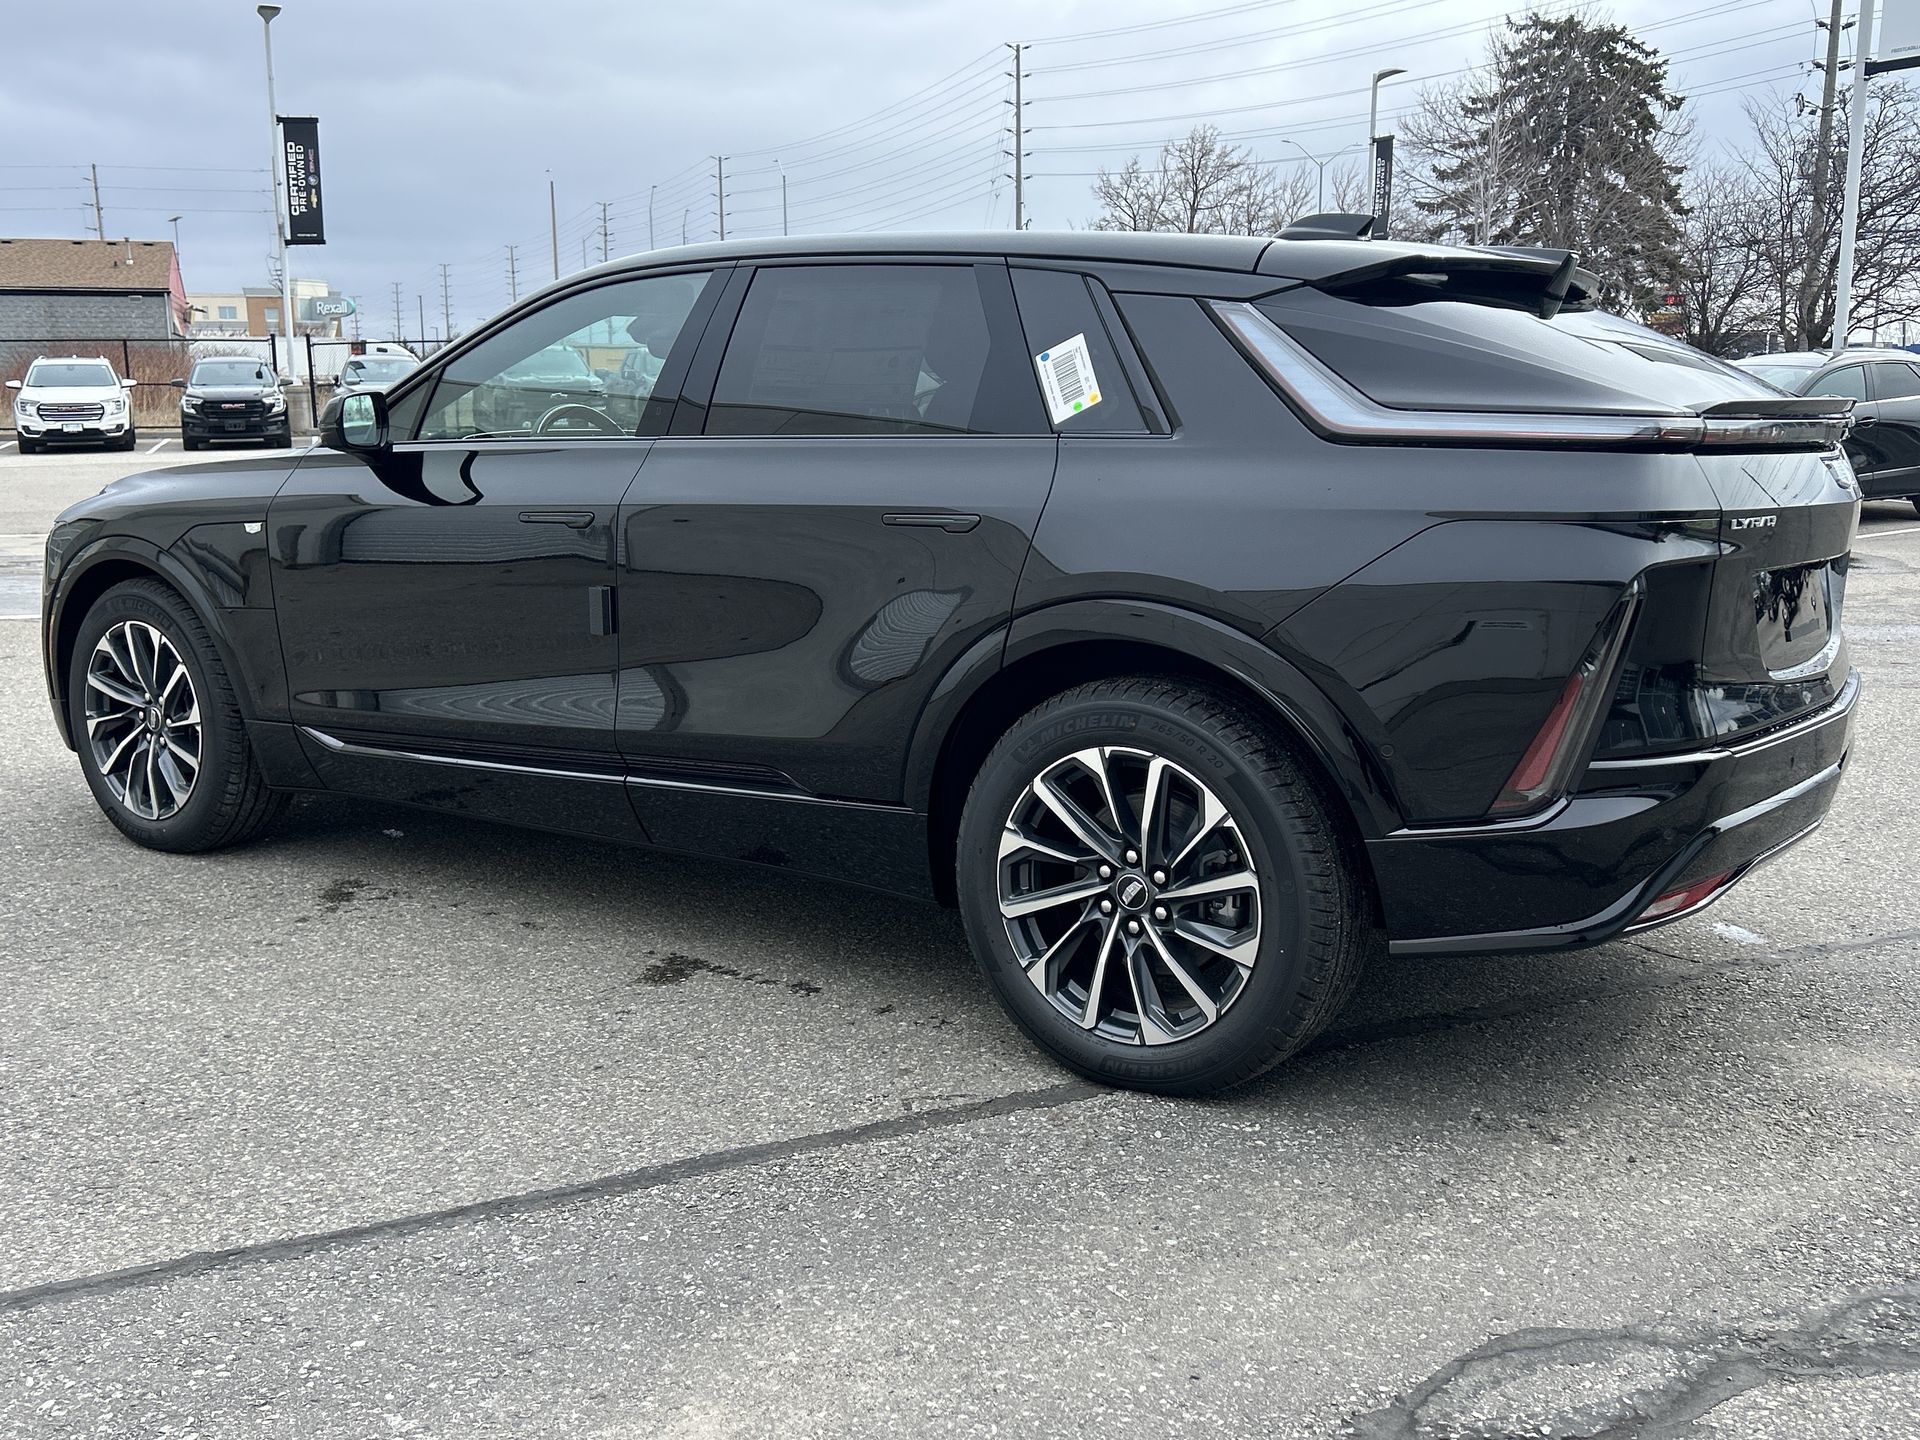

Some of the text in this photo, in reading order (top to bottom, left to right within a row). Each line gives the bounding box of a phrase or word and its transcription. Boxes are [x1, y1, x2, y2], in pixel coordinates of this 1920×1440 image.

[286, 141, 300, 216] CERTIFIED
[296, 145, 308, 213] PRE-OWNED
[1374, 157, 1382, 219] CERTIFIED
[316, 300, 348, 315] Rexall
[1040, 714, 1136, 744] MICHELIN
[1150, 721, 1196, 748] 265/50
[1207, 753, 1225, 770] 20
